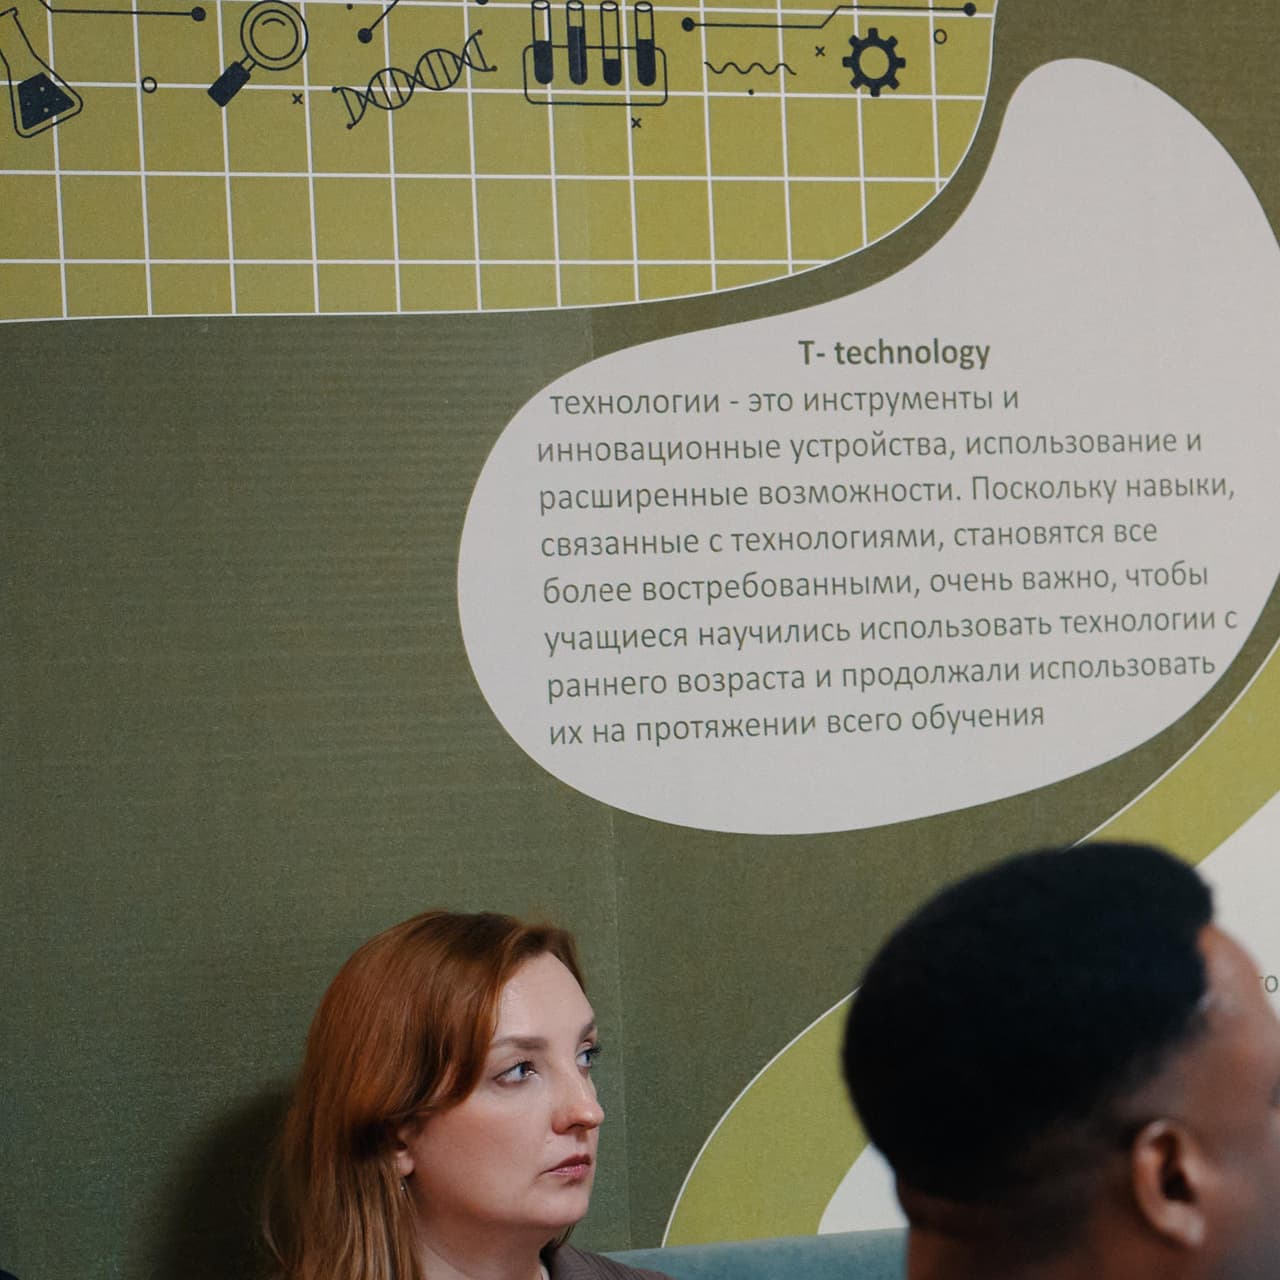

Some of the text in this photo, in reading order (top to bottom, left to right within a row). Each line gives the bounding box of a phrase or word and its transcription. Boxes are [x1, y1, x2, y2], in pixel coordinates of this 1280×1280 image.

[797, 336, 992, 371] T- technology
[549, 392, 720, 416] технологии
[747, 392, 794, 413] это
[803, 390, 993, 418] инструменты
[1002, 389, 1019, 410] и
[537, 429, 1202, 467] инновационные устройства, использование и
[539, 475, 1235, 517] расширенные возможности. Поскольку навыки,
[540, 522, 1158, 558] связанные с технологиями, становятся все
[543, 559, 1208, 607] более востребованными, очень важно, чтобы
[543, 609, 1238, 659] учащиеся научились использовать технологии с
[547, 655, 1216, 706] раннего возраста и продолжали использовать
[549, 702, 1045, 748] их на протяжении всего обучения
